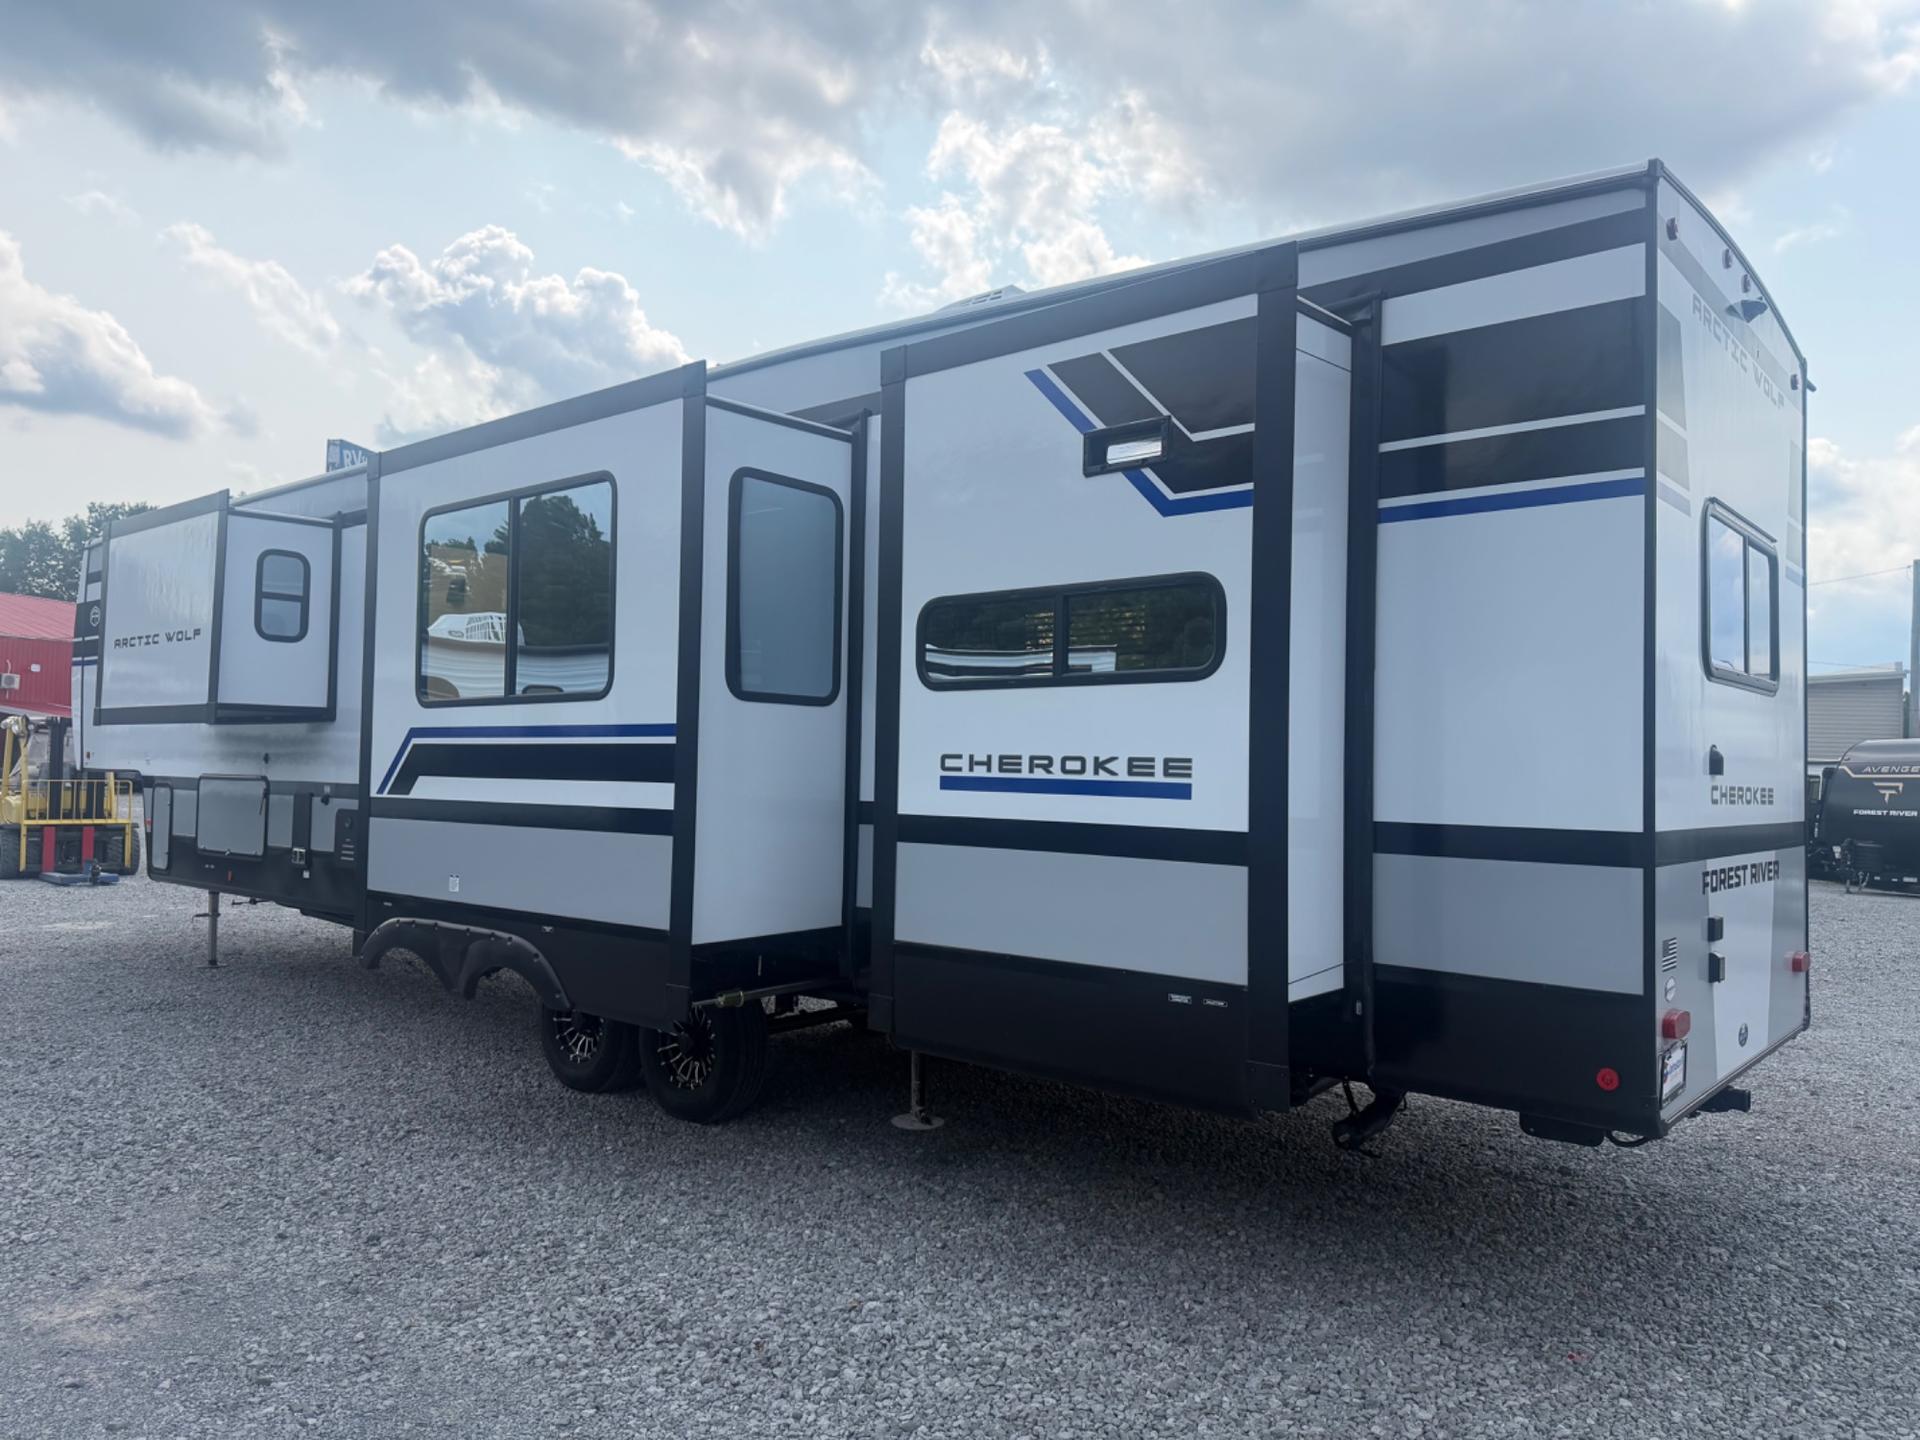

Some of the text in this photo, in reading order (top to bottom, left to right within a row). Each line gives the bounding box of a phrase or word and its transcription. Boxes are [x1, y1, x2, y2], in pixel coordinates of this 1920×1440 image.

[1692, 293, 1785, 410] ARCTIC WOLF
[113, 628, 202, 650] ARCTIC WOLF
[939, 753, 1193, 779] CHEROKEE
[1711, 784, 1775, 806] CHEROKEE
[1852, 808, 1919, 818] FOREST RIVER
[1702, 860, 1781, 896] FOREST RIVER
